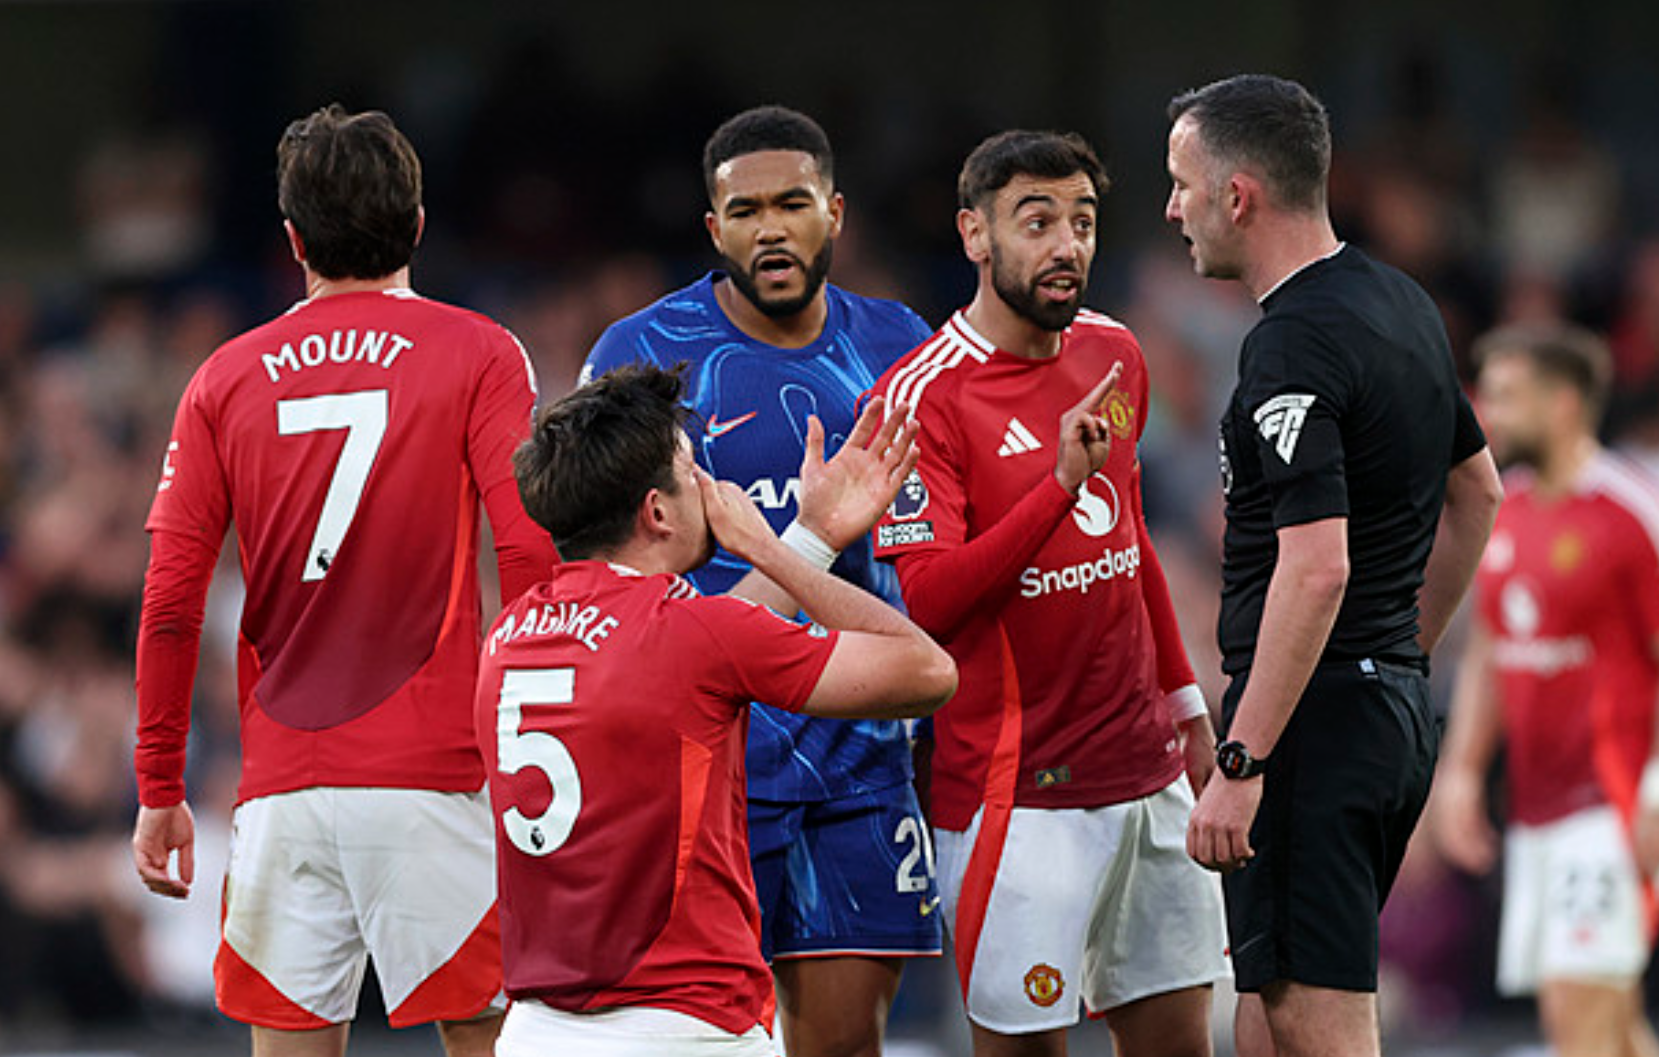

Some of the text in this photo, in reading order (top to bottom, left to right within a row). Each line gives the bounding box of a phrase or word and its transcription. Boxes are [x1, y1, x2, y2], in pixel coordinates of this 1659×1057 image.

[262, 330, 413, 382] MOUNT
[277, 389, 388, 581] 7
[496, 668, 582, 856] 5
